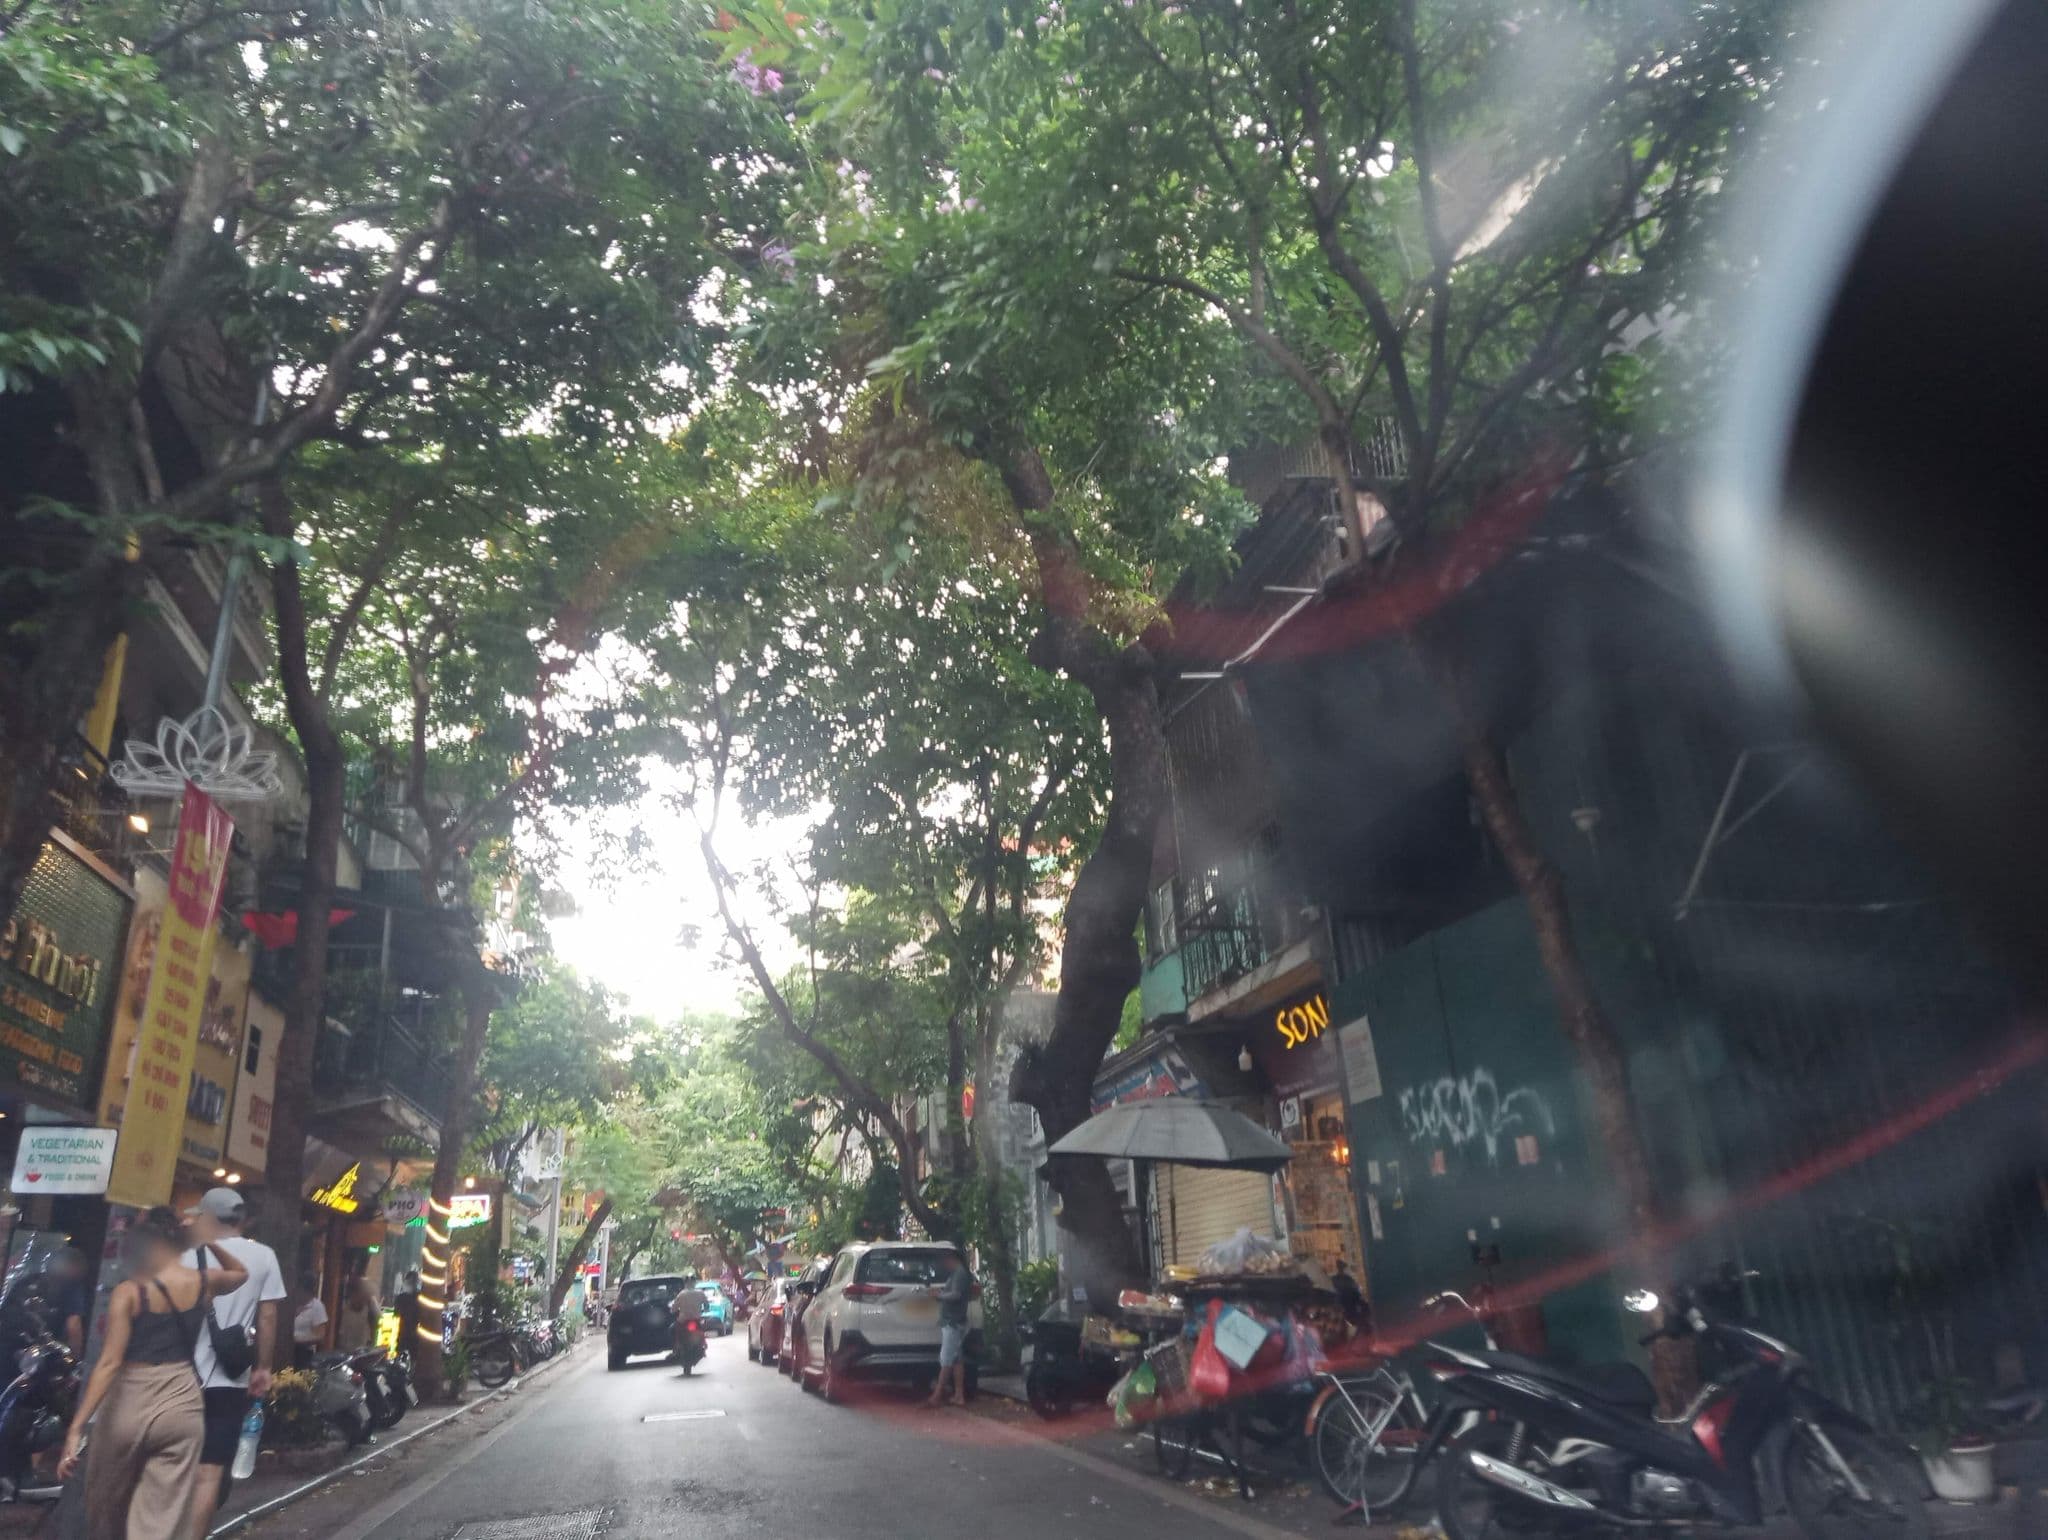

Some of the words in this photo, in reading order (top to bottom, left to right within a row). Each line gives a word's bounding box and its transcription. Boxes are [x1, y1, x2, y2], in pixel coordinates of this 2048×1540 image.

[31, 1137, 104, 1150] VEGETARIAN
[27, 1154, 35, 1164] &
[38, 1154, 102, 1165] TRADITIONAL
